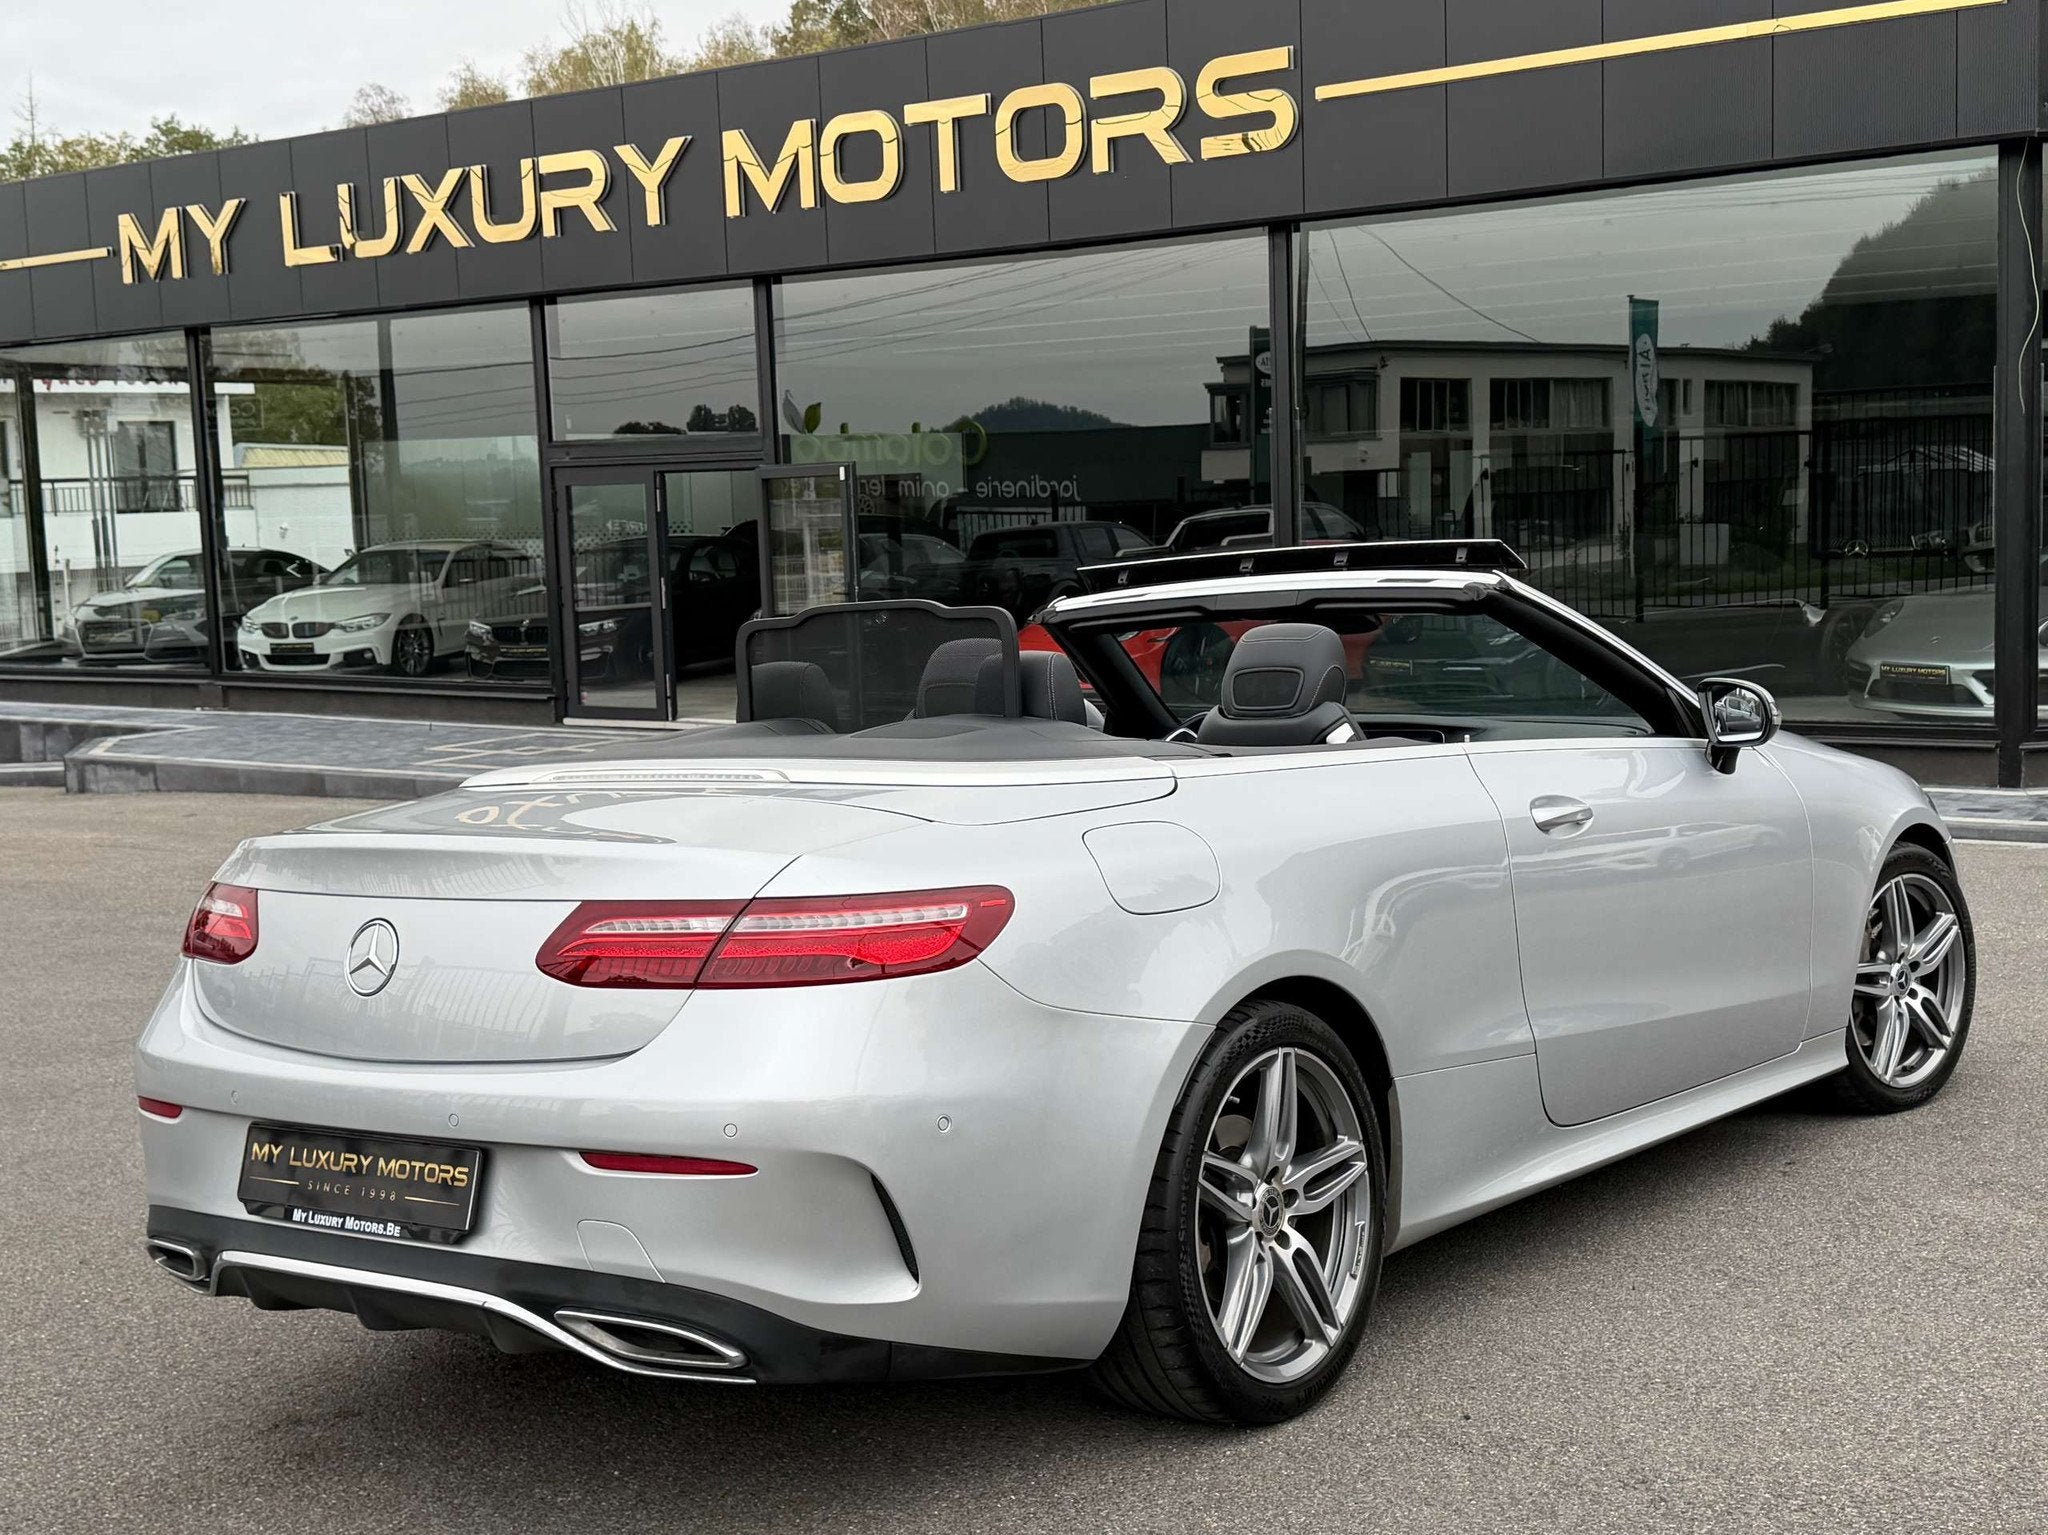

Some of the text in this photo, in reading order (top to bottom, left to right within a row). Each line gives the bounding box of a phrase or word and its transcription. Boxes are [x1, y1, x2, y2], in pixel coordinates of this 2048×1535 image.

[117, 45, 1296, 284] MY LUXURY MOTORS
[251, 1142, 469, 1187] MY LUXURY MOTORS
[307, 1180, 396, 1201] SINCE 1998
